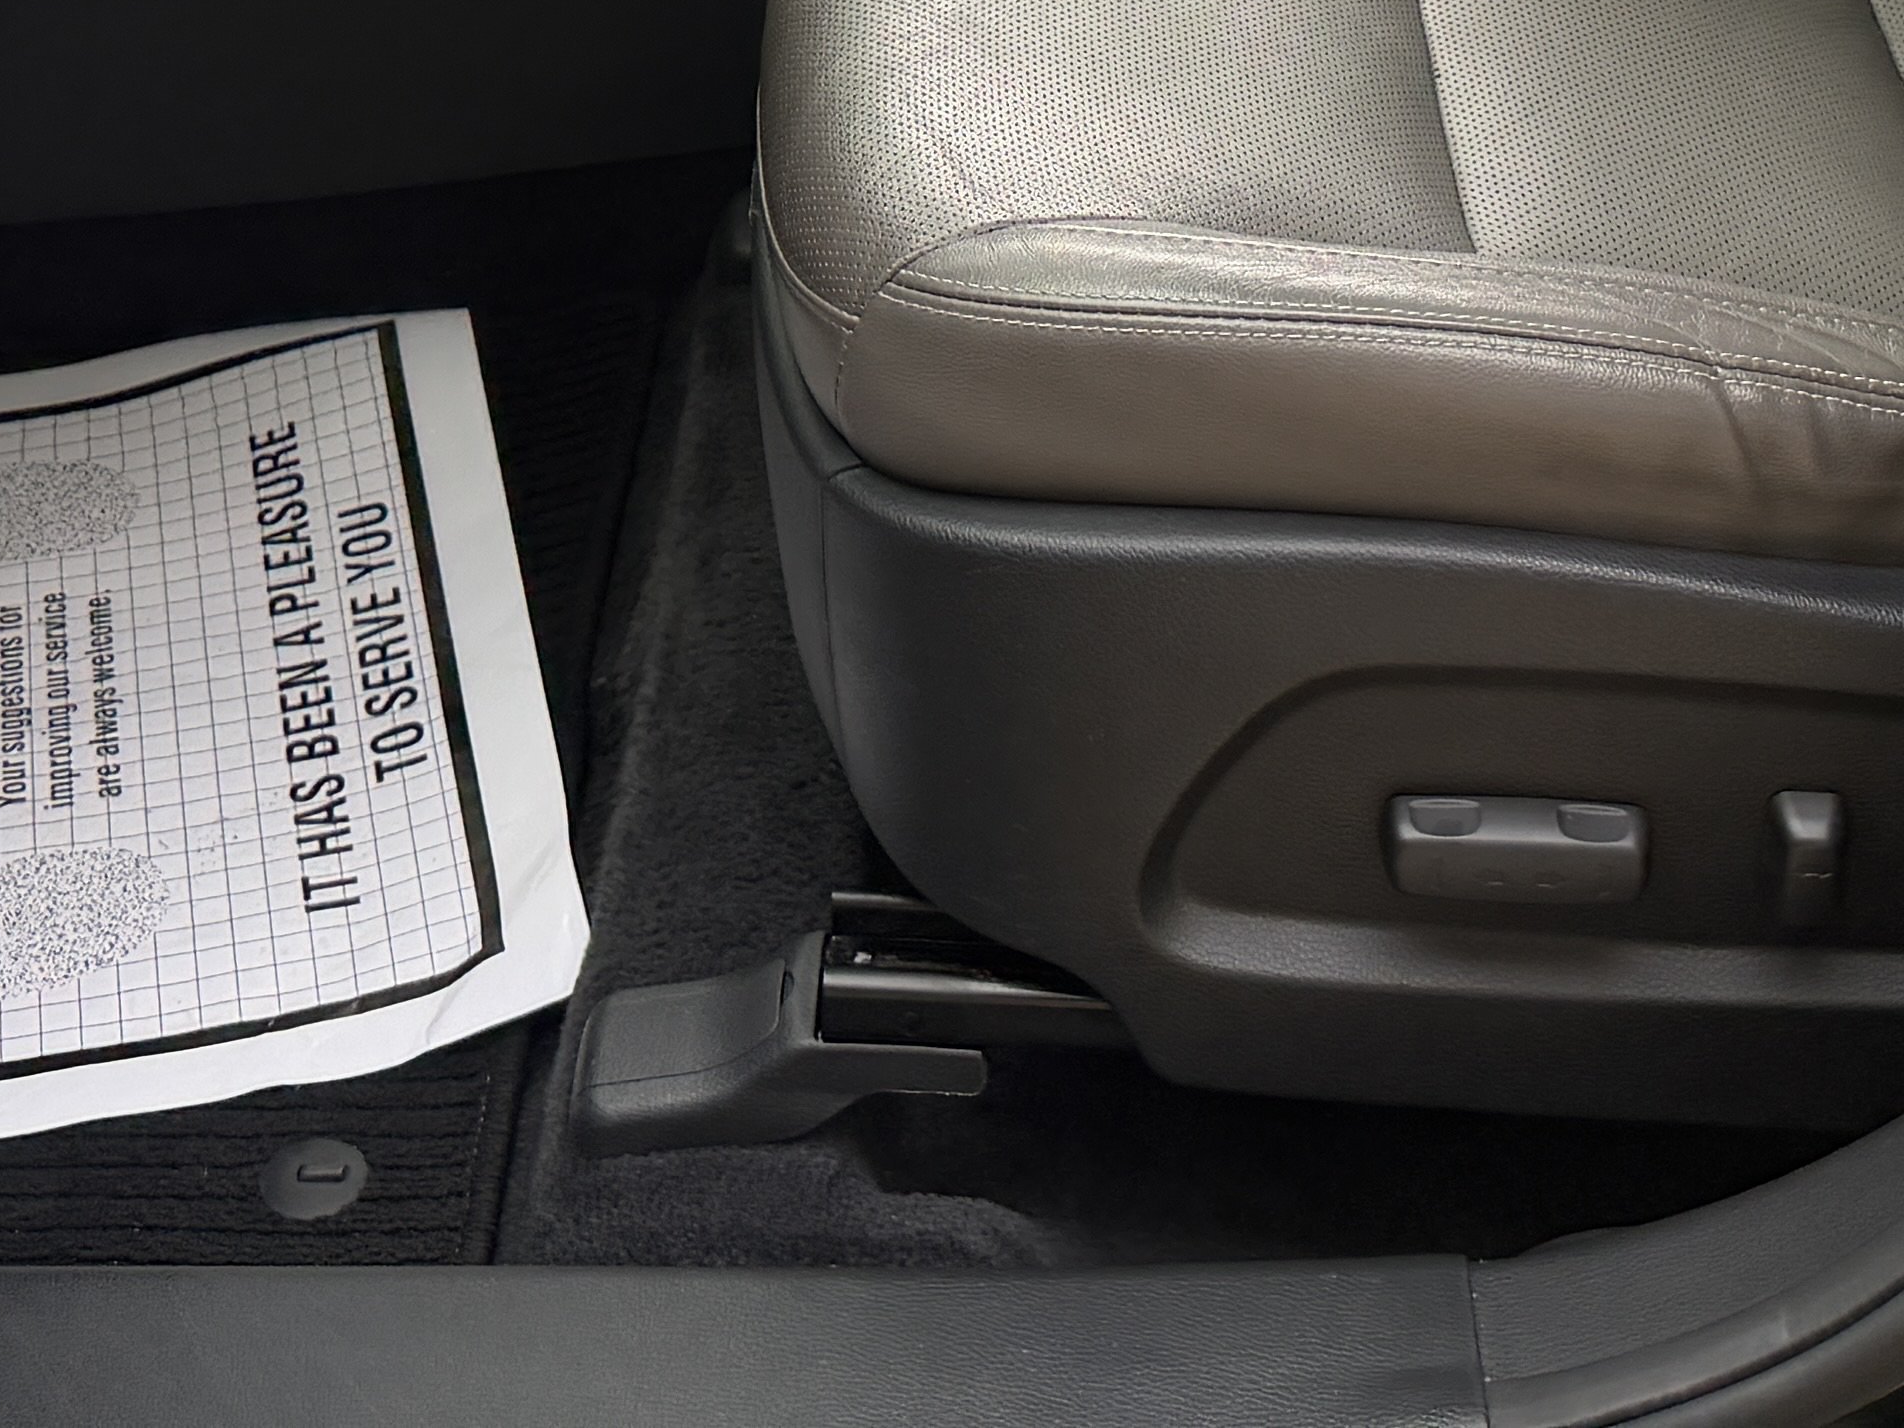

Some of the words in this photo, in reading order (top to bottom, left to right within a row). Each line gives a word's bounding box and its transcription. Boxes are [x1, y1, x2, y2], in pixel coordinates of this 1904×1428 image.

[249, 421, 319, 617] PLEASURE
[337, 502, 395, 584] YOU
[39, 592, 68, 664] service
[273, 621, 325, 647] A
[350, 586, 419, 717] SERVE
[48, 668, 69, 699] our
[276, 659, 340, 763] BEEN
[44, 703, 80, 810] improving
[89, 686, 123, 756] always
[370, 721, 428, 783] TO
[97, 763, 121, 798] are
[289, 774, 353, 860] HAS
[301, 875, 361, 913] IT
